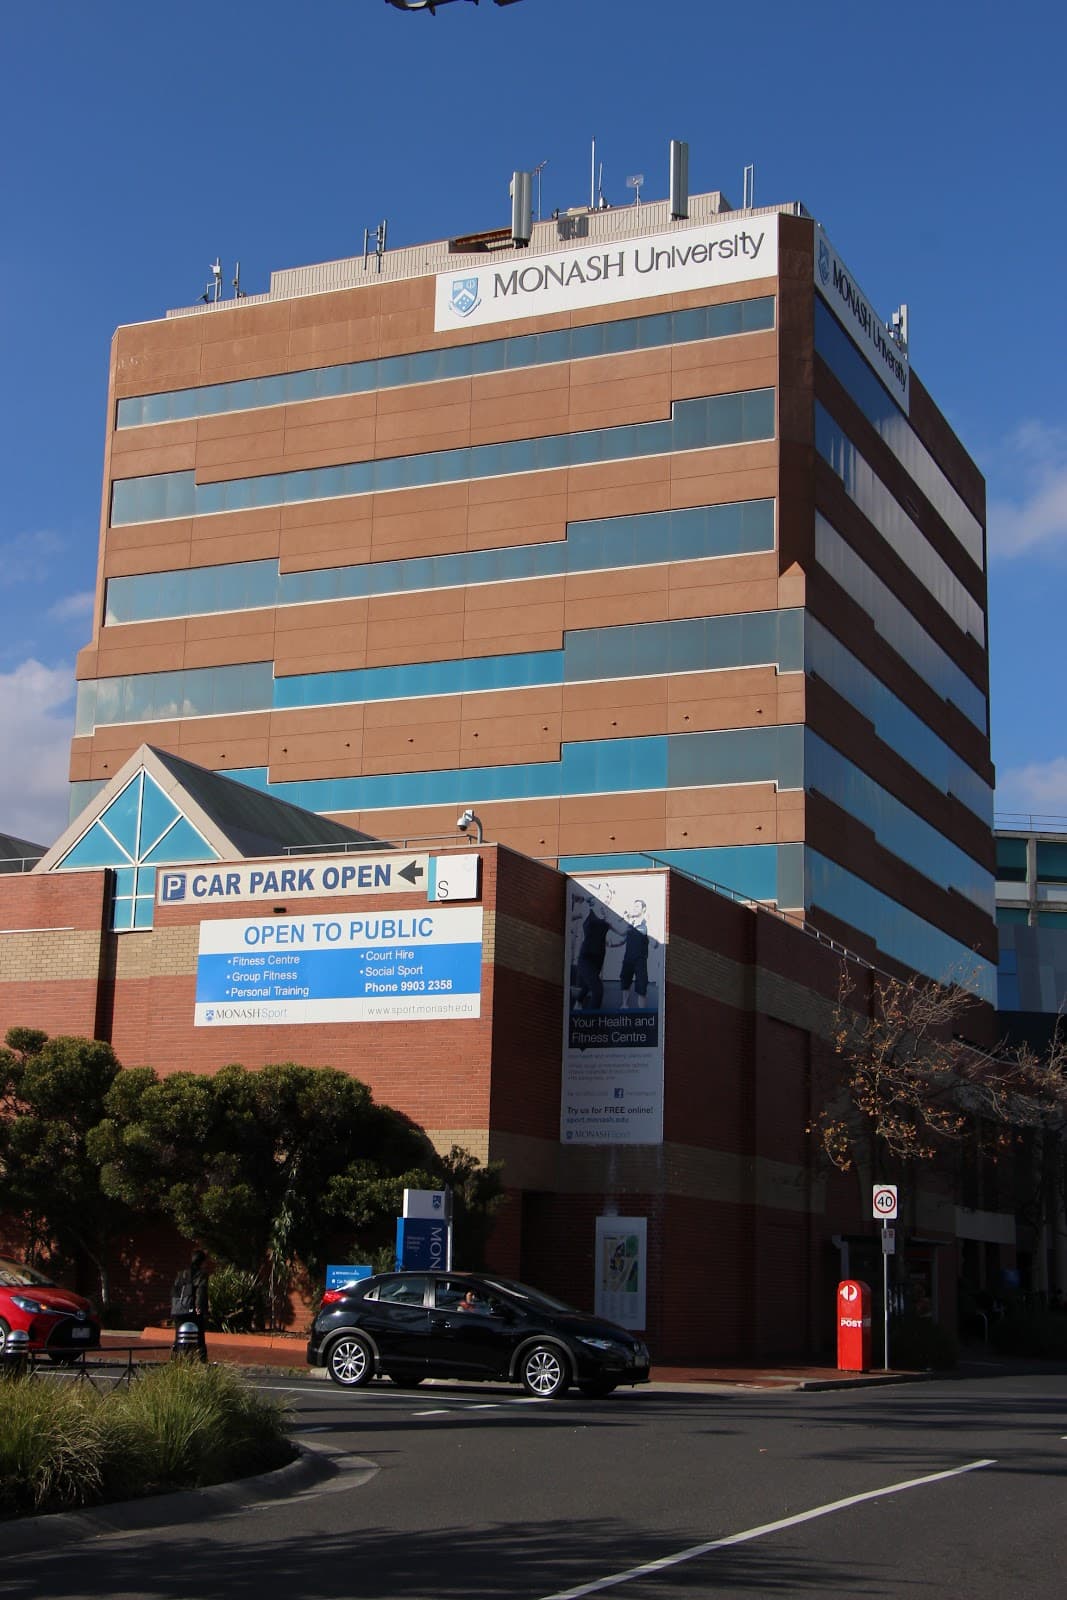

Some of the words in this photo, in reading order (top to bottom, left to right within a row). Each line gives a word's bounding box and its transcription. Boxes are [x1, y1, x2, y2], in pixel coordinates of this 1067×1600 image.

[493, 251, 625, 298] MONASH
[634, 230, 765, 273] University
[832, 260, 871, 339] MONASH
[873, 323, 908, 392] University
[192, 872, 241, 897] CAR
[249, 867, 315, 894] PARK
[322, 863, 392, 890] OPEN
[437, 880, 449, 898] S
[244, 924, 305, 945] OPEN
[312, 922, 342, 942] TO
[350, 917, 434, 941] PUBLIC
[232, 956, 265, 967] Fitness
[267, 954, 300, 965] Centre
[365, 951, 393, 961] Court
[395, 949, 415, 960] Hire
[232, 972, 261, 983] Group
[263, 970, 298, 981] Fitness
[365, 966, 395, 977] Social
[397, 965, 423, 978] Sport
[230, 986, 271, 998] Personal
[274, 985, 310, 998] Training
[365, 982, 398, 993] Phone
[400, 981, 425, 992] 9903
[427, 979, 453, 991] 2358
[572, 1016, 595, 1028] Your
[599, 1015, 632, 1027] Health
[634, 1015, 655, 1027] and
[571, 1032, 609, 1043] Fitness
[611, 1031, 647, 1042] Centre
[567, 1106, 579, 1115] Try
[591, 1106, 602, 1114] for
[604, 1106, 625, 1114] FREE
[877, 1196, 893, 1207] 40
[430, 1227, 442, 1272] MON
[840, 1319, 862, 1328] POST
